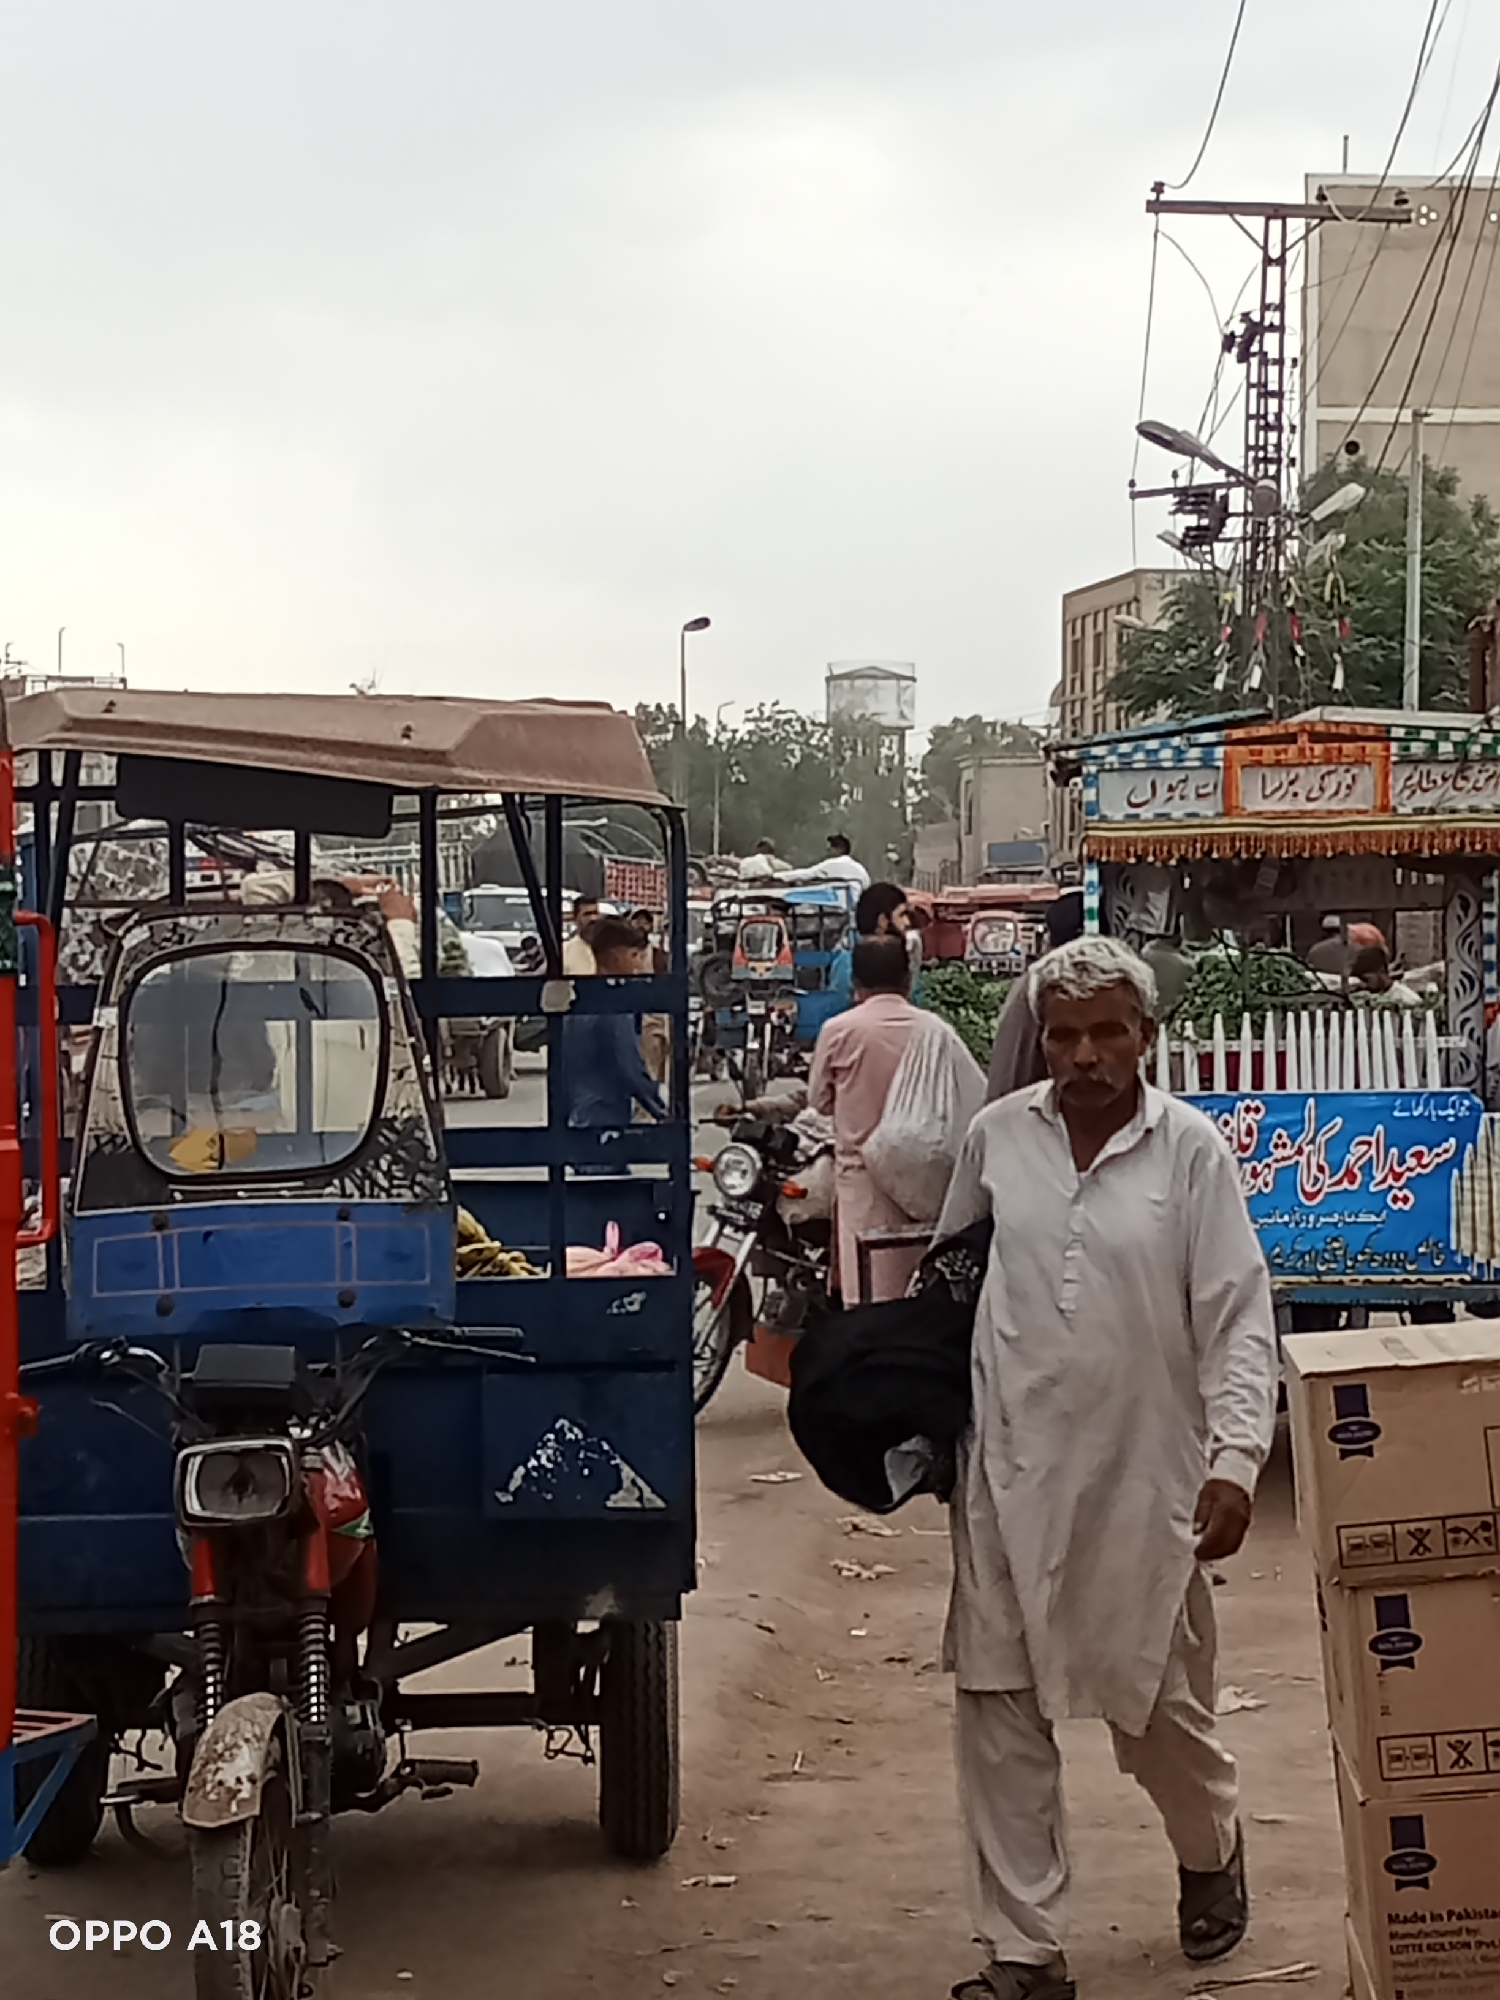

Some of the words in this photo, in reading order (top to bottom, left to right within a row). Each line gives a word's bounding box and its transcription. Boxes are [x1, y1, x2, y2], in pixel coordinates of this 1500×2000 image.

[1326, 1123, 1386, 1191] احمد
[1370, 1137, 1457, 1211] سعید
[1387, 1911, 1426, 1924] Made
[1447, 1908, 1500, 1922] Pakista
[1390, 1943, 1423, 1954] LOTTE
